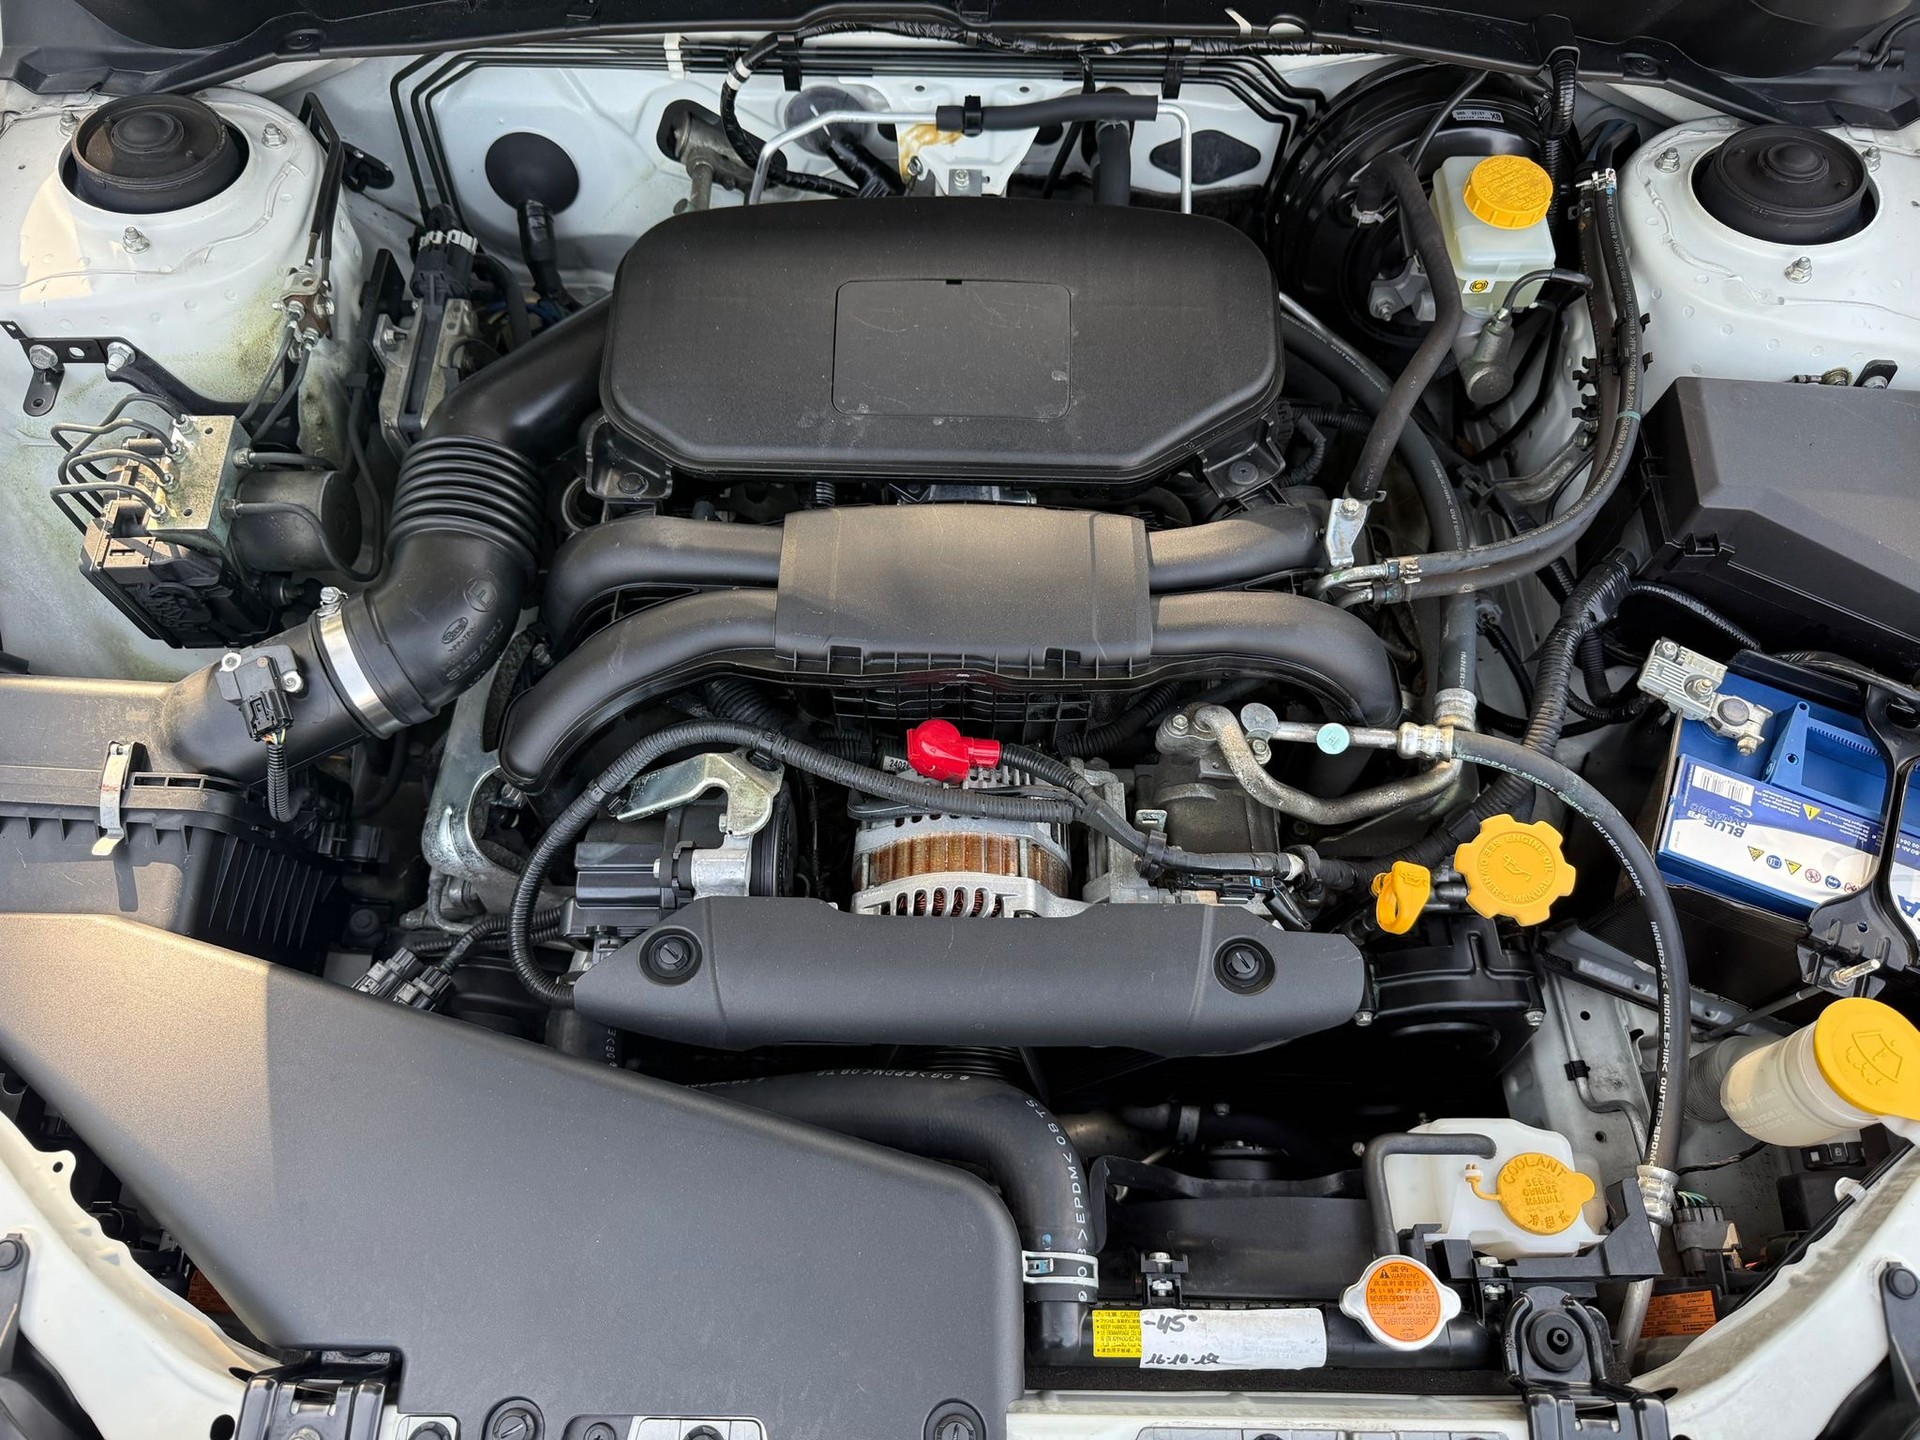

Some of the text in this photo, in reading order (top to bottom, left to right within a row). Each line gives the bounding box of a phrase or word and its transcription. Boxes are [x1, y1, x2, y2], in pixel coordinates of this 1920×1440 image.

[446, 618, 504, 681] SUBARU
[1704, 817, 1746, 838] BLUE
[1505, 833, 1553, 876] ENGINE OIL
[1592, 820, 1647, 897] OUTER>EPDM<
[1484, 839, 1501, 857] SEE
[1512, 880, 1551, 903] MANUAL
[1503, 1156, 1567, 1184] COOLANT
[1525, 1177, 1543, 1187] SEE
[1522, 1185, 1557, 1196] OWNERS
[1525, 1195, 1560, 1206] MANUAL
